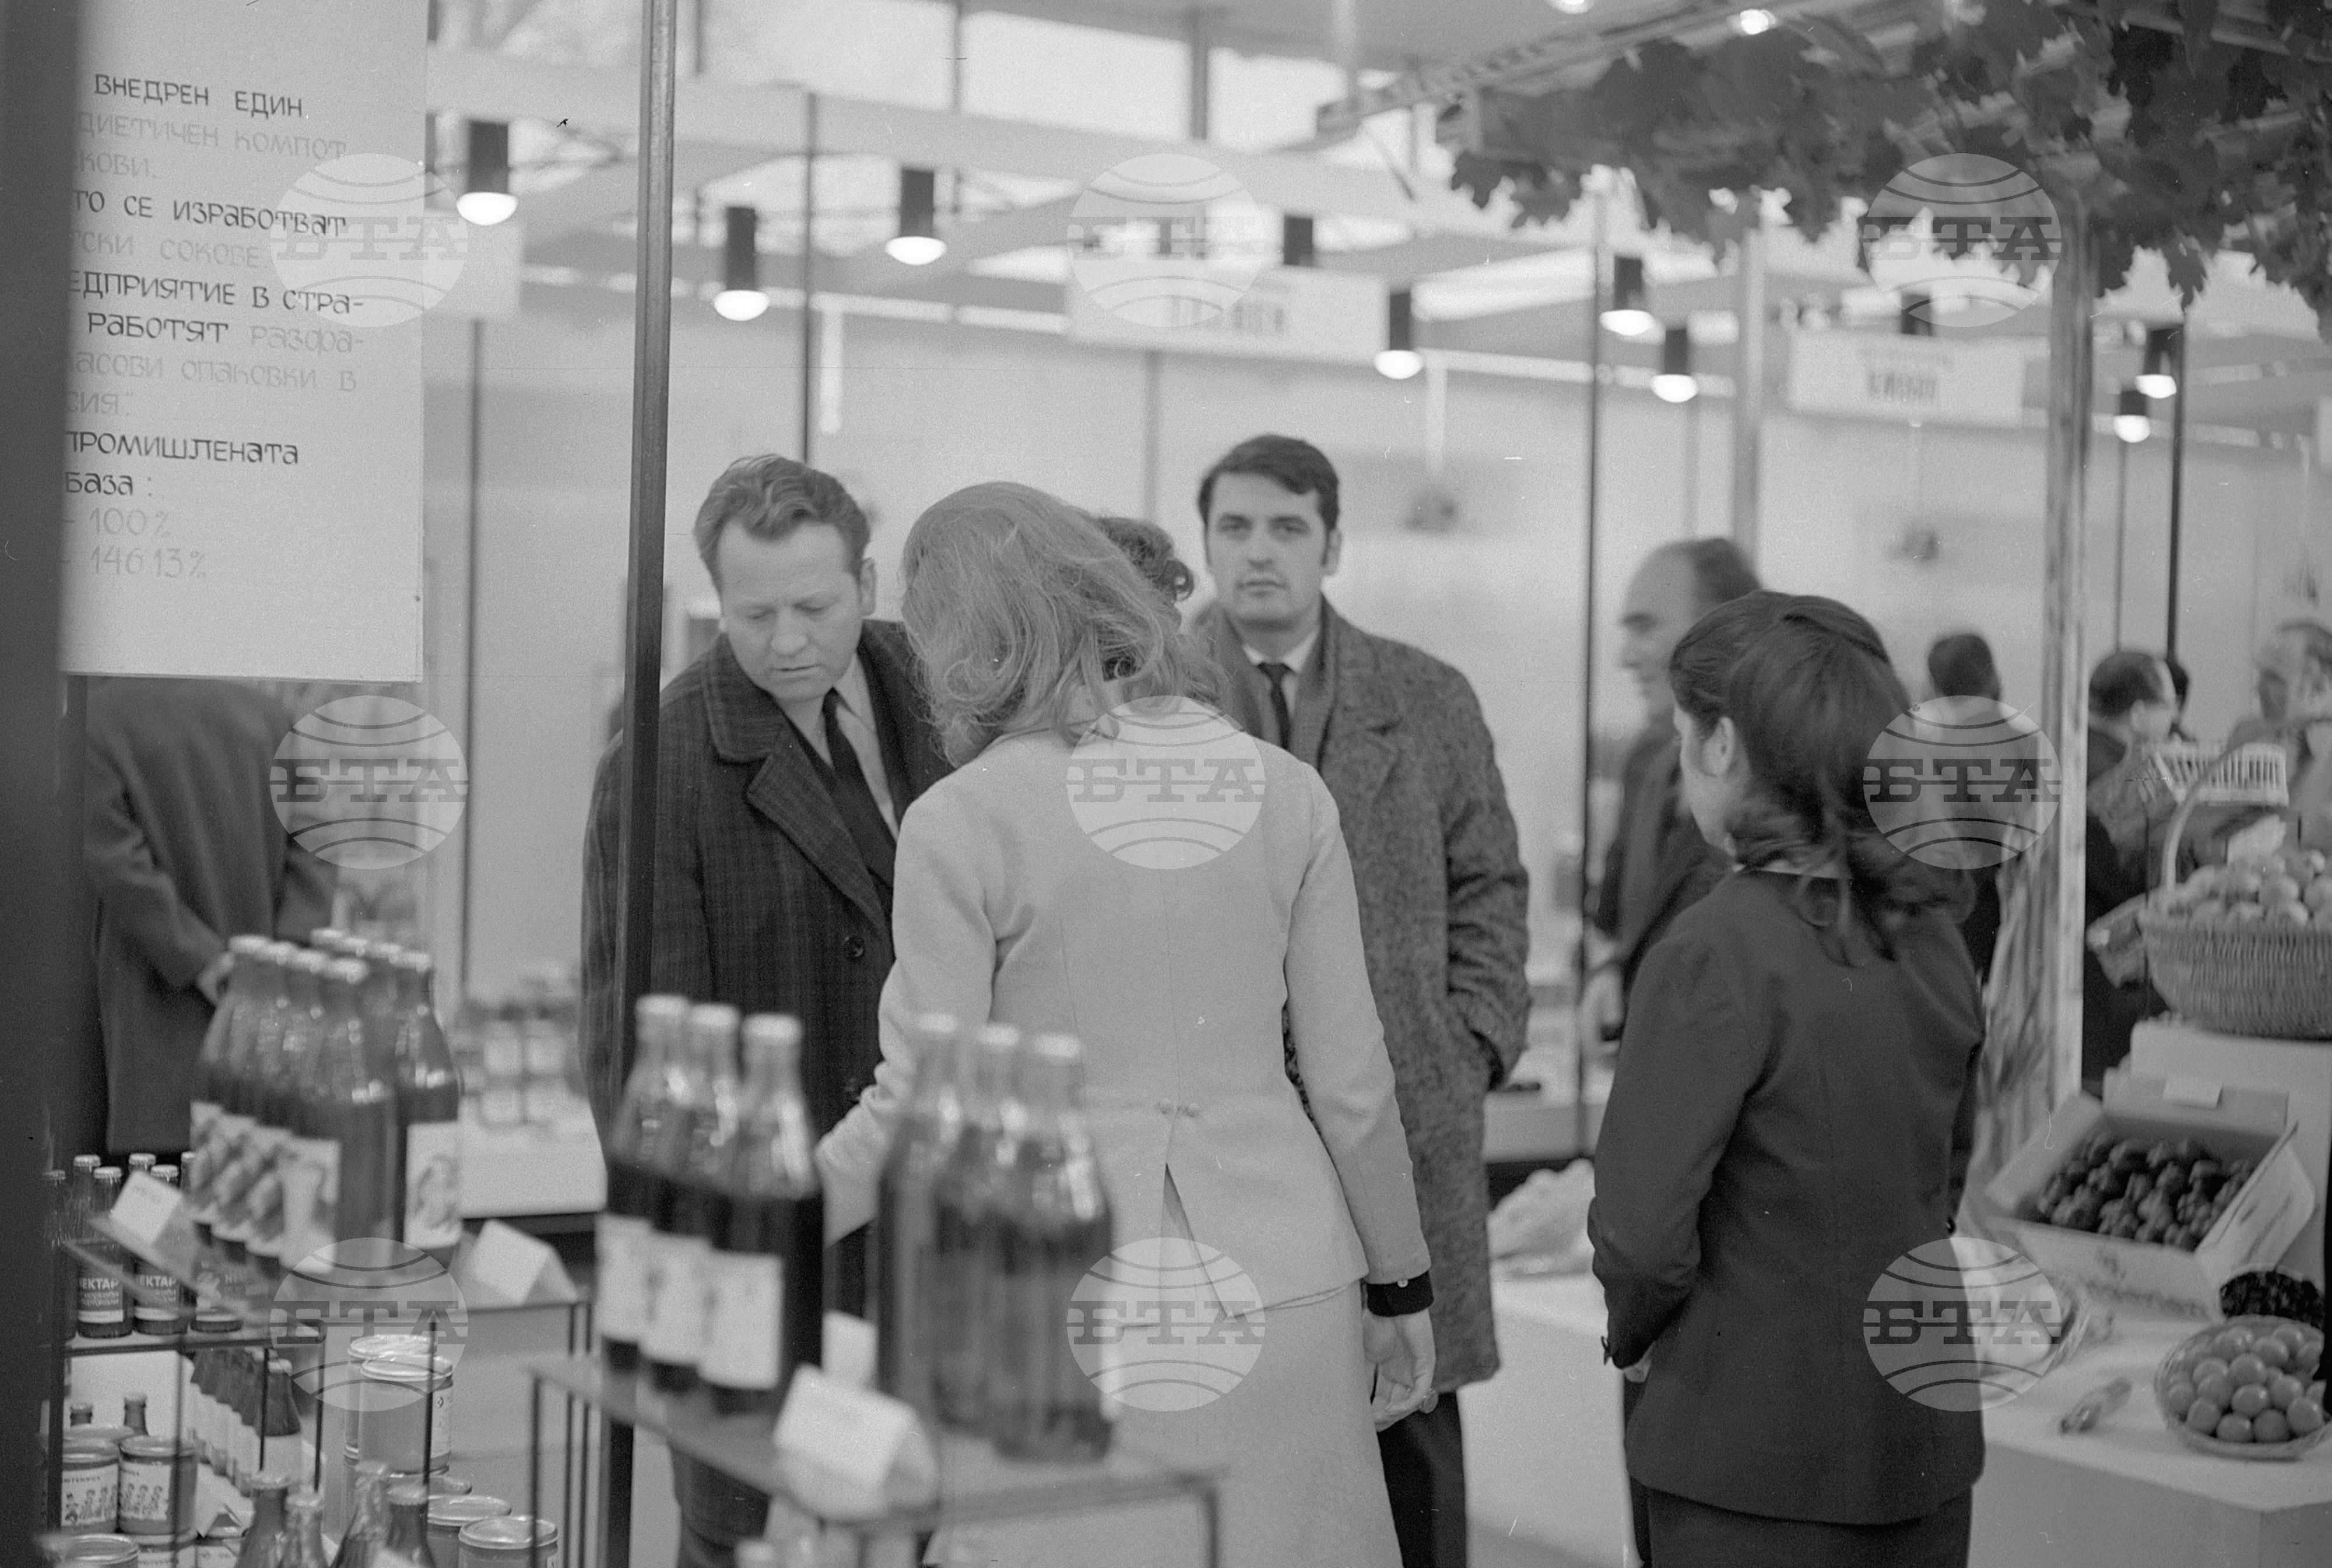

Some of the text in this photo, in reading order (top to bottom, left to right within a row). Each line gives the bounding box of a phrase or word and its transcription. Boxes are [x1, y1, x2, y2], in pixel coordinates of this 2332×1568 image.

[94, 73, 303, 119] ВНЕДРЕН ЕДИН
[76, 111, 347, 161] ДИЕТИЧЕН КОМПОТ
[123, 195, 154, 219] СЕ
[252, 286, 270, 308] В
[339, 370, 358, 392] В
[80, 1277, 118, 1290] ЕКТАР
